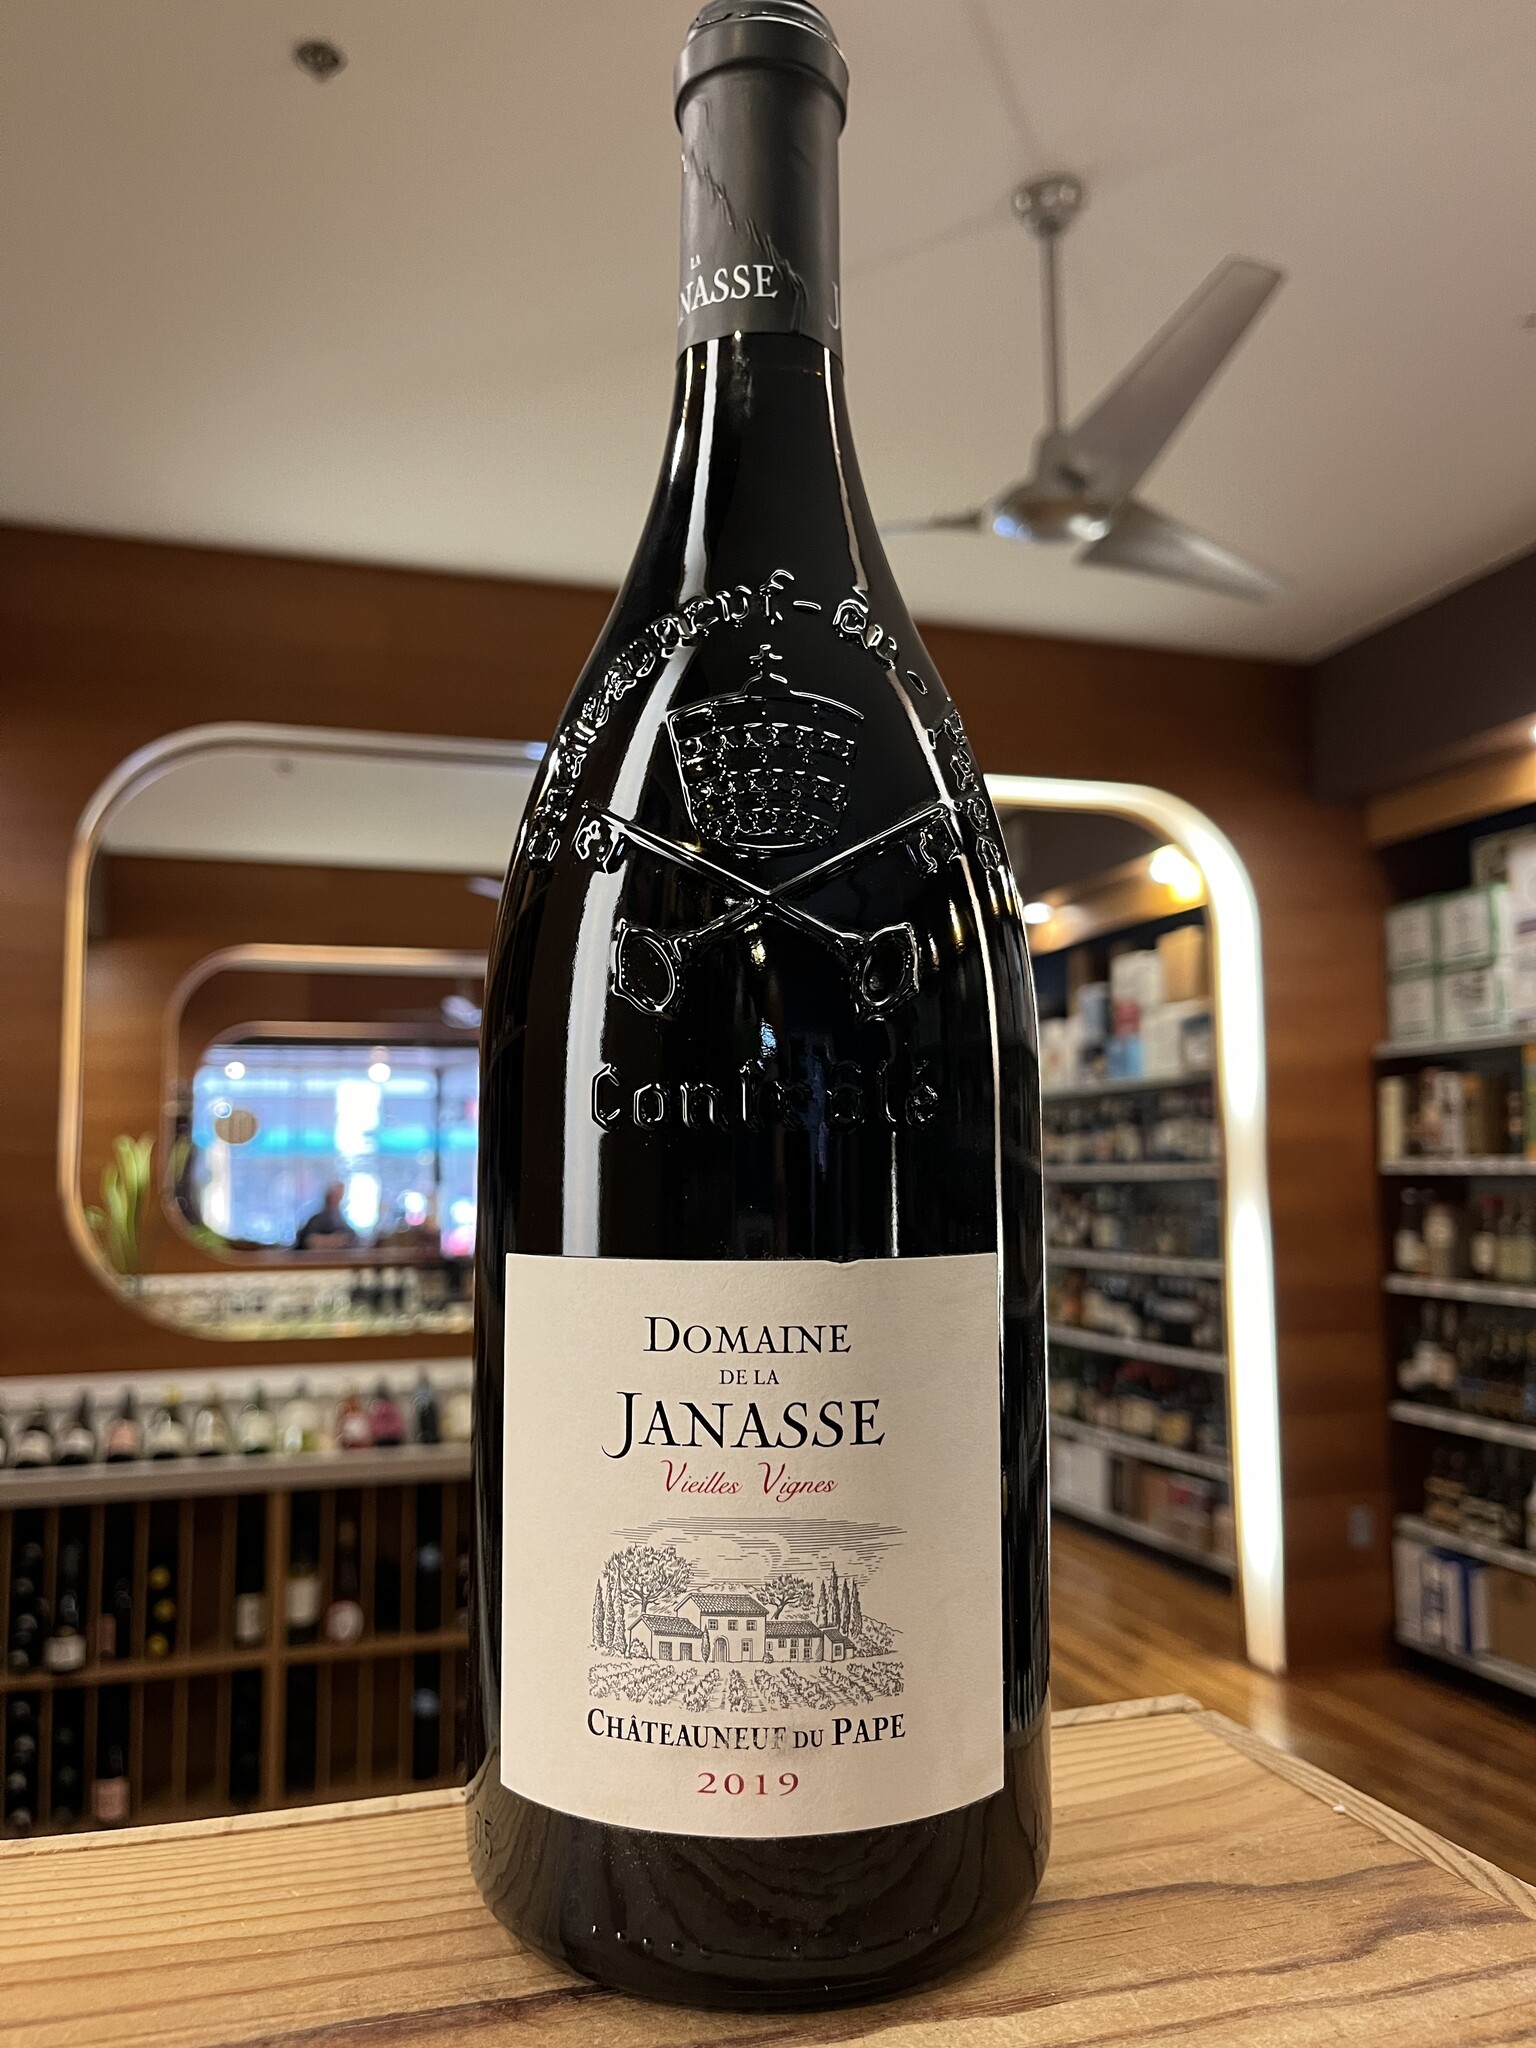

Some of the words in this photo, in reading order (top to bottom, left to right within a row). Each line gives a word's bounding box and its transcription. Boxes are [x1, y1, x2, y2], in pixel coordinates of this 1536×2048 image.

[643, 1316, 852, 1354] DOMAINE
[719, 1369, 748, 1385] DE
[753, 1369, 780, 1385] LA
[601, 1391, 886, 1459] JANASSE
[660, 1459, 743, 1494] Vieilles
[757, 1461, 838, 1502] Vignes
[587, 1708, 786, 1750] CHÂTEAUNEUF
[793, 1730, 824, 1748] DU
[831, 1714, 906, 1745] PAPE
[697, 1772, 799, 1796] 2019
